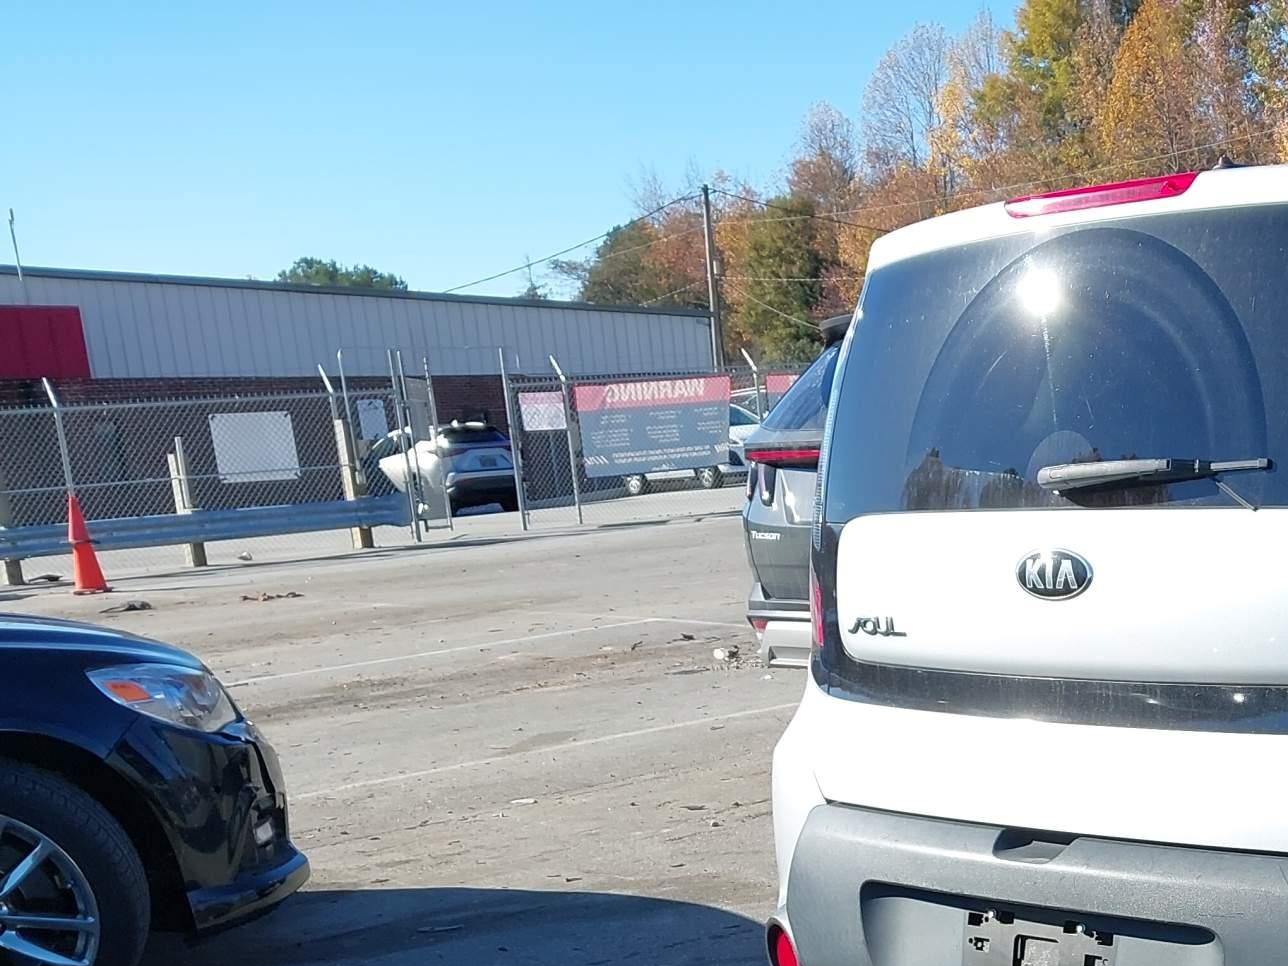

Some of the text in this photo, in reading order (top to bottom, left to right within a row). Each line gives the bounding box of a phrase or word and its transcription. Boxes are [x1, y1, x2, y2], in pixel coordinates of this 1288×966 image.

[751, 530, 781, 540] Tucson
[1024, 559, 1078, 589] KIA
[847, 616, 907, 637] SOUL
